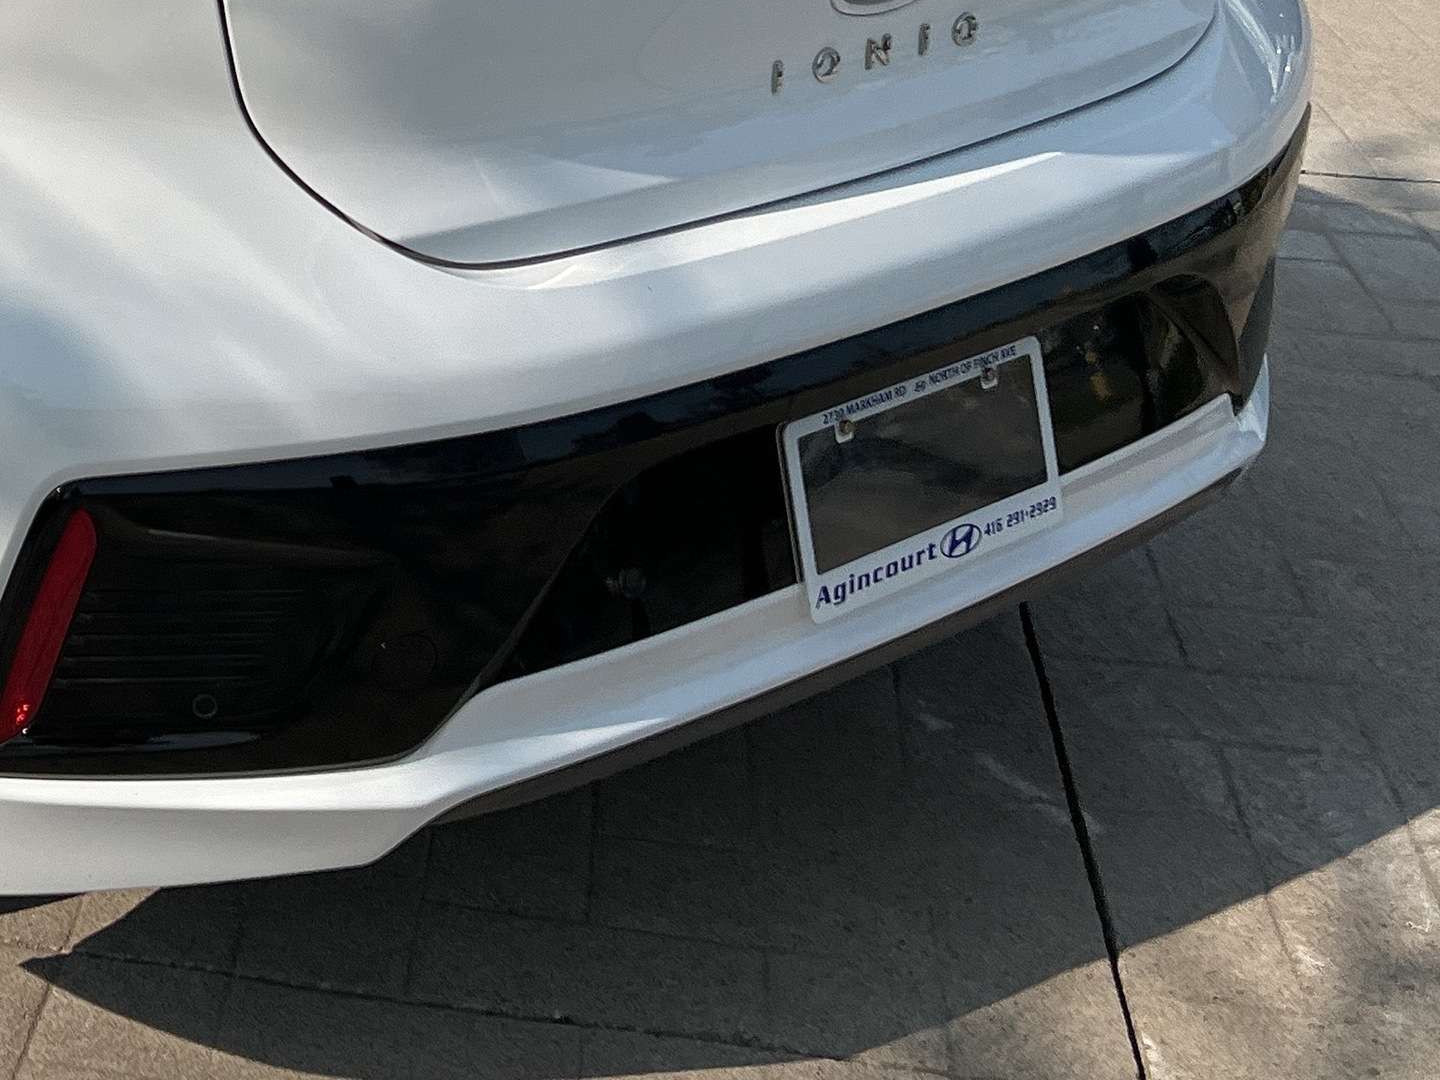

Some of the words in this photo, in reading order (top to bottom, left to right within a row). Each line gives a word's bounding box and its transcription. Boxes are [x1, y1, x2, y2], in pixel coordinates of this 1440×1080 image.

[770, 11, 980, 97] IONIQ
[814, 541, 938, 610] Agincourt
[983, 517, 1004, 536] 416
